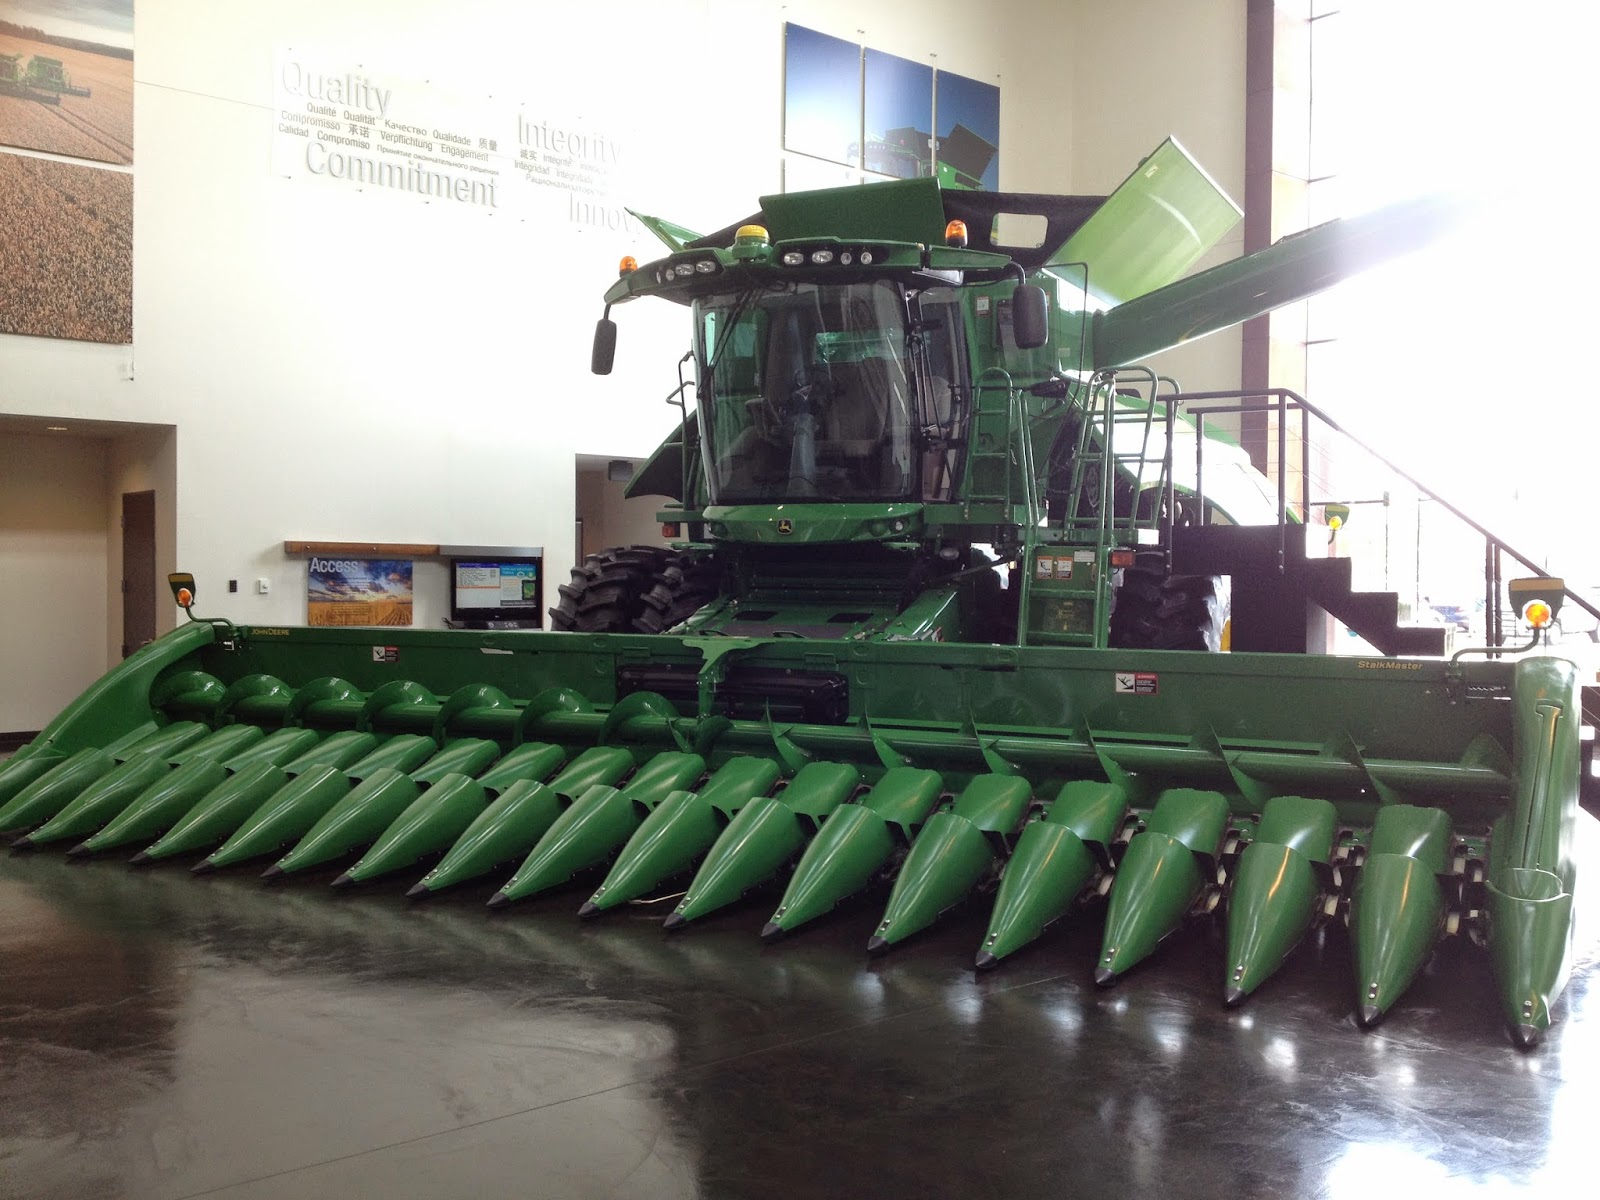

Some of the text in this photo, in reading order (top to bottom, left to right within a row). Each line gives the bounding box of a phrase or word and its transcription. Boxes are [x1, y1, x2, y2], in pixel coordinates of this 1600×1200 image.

[282, 62, 392, 120] Quality
[281, 109, 341, 131] Compromisso
[306, 102, 376, 126] Qualité Qualität
[278, 122, 371, 150] Calidad Compromiso
[384, 118, 428, 137] Качество
[432, 129, 472, 146] Qualidade
[380, 130, 489, 163] Verpflichtung Engagement
[517, 113, 622, 167] Integrity
[305, 140, 498, 209] Commitment
[514, 159, 551, 176] Integridad
[310, 557, 358, 573] Access
[1357, 660, 1424, 670] StalkMaster
